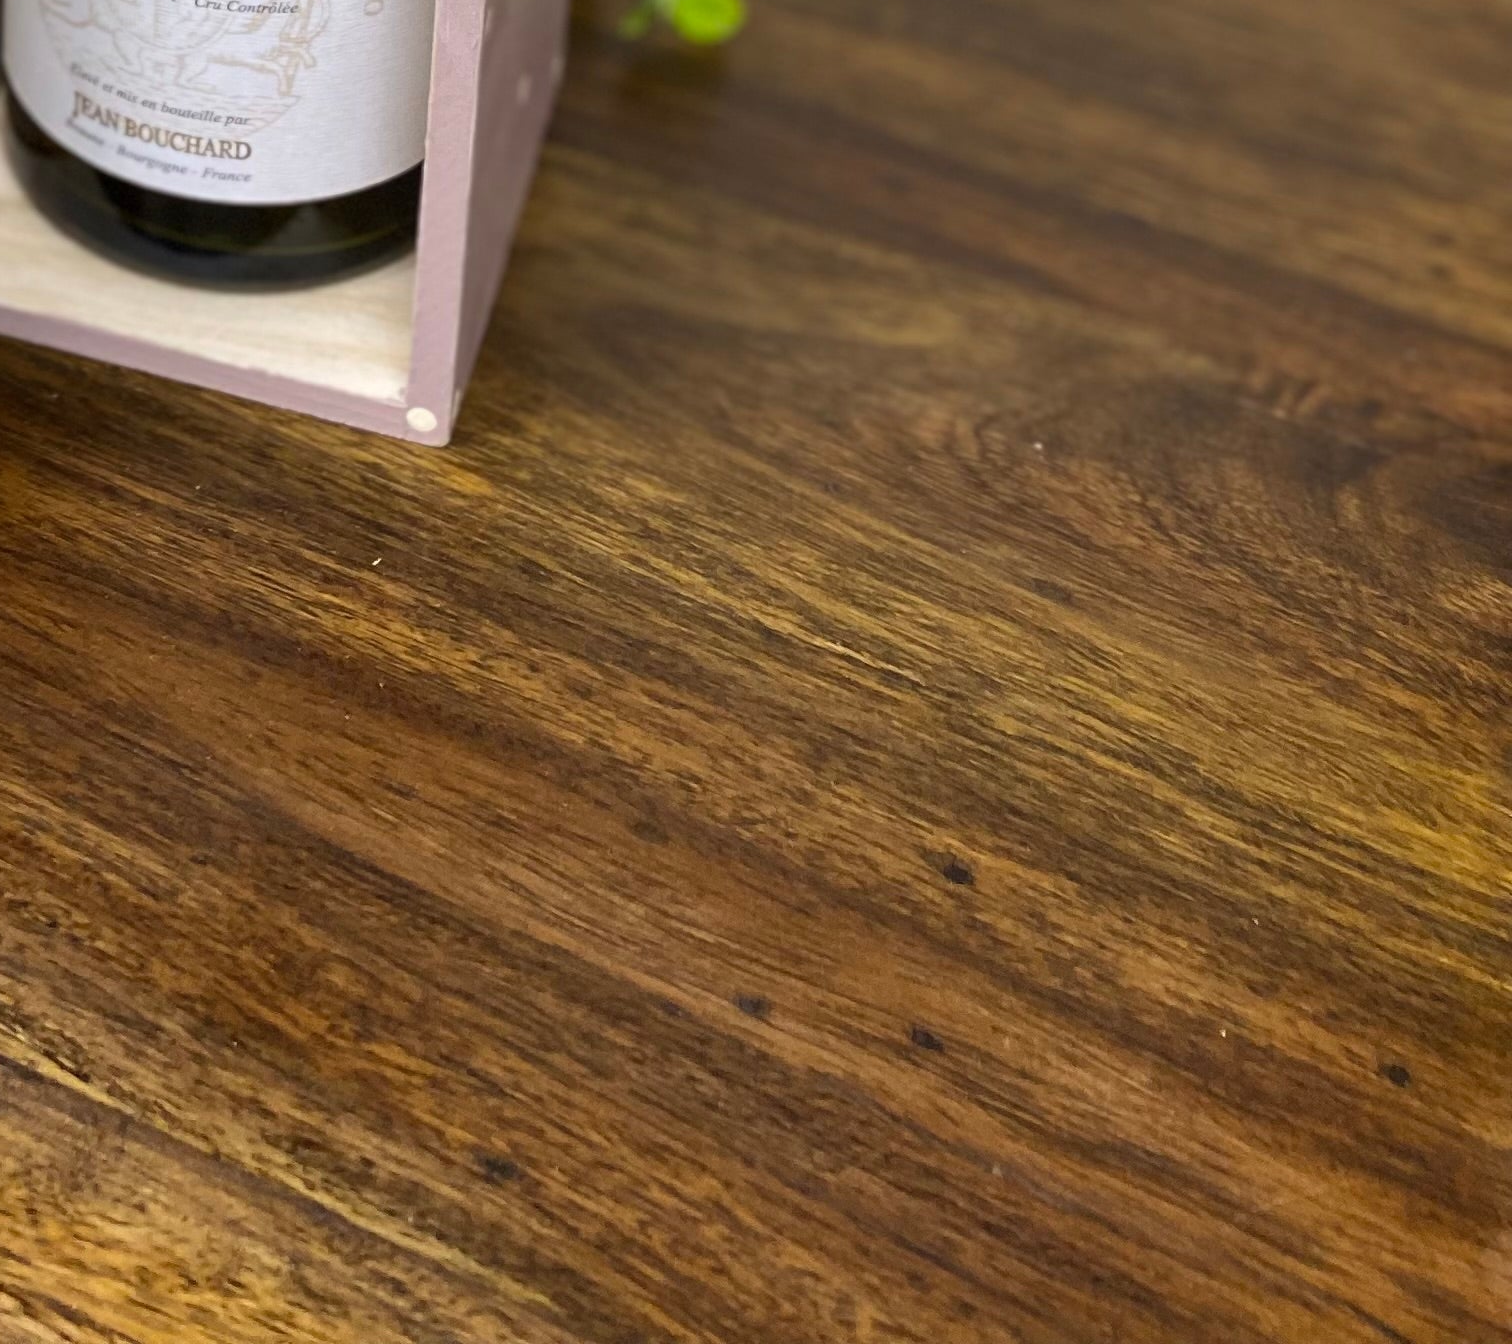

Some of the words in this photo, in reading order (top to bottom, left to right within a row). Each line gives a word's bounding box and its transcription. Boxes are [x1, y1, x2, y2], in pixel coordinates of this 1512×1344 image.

[72, 90, 120, 132] JEAN
[124, 117, 253, 161] BOUCHARD
[160, 100, 222, 124] bouteille
[224, 114, 250, 127] par
[200, 166, 253, 183] France
